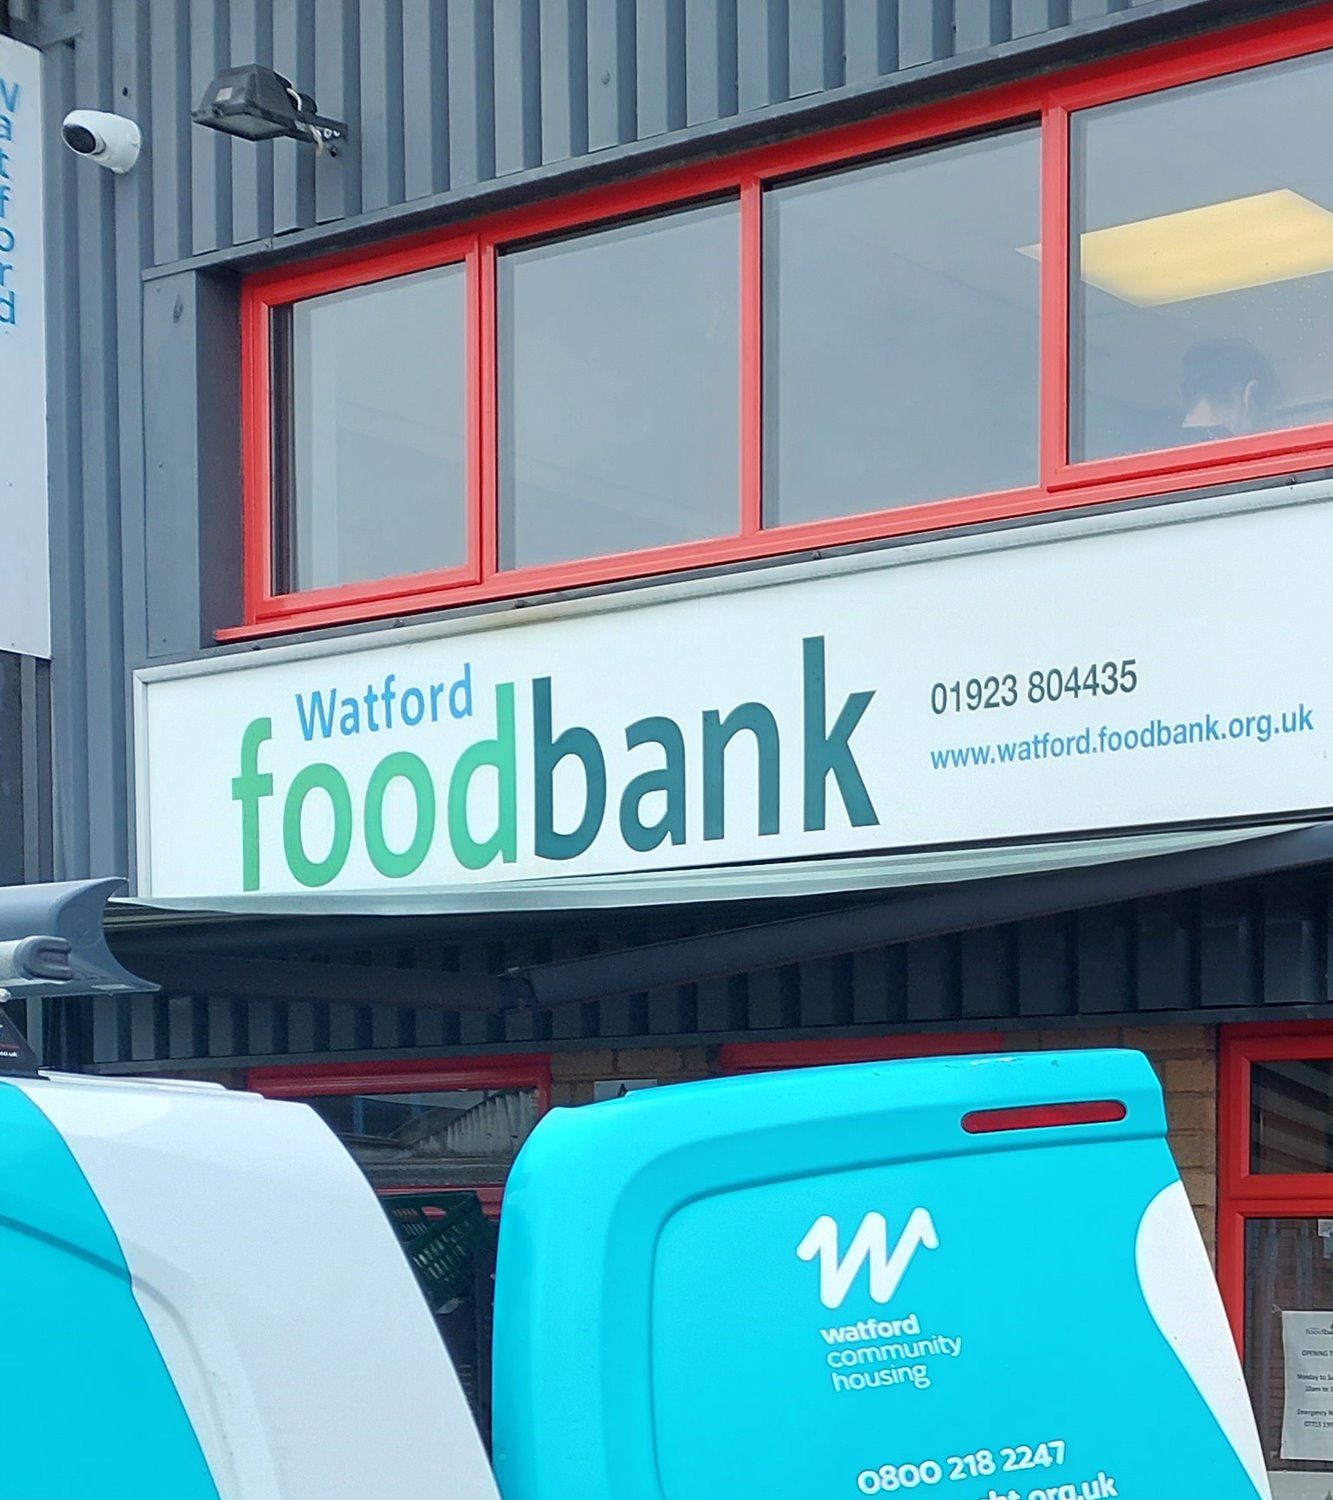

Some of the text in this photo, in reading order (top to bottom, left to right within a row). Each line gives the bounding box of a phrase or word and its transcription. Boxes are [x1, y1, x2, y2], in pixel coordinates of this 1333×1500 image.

[296, 663, 473, 742] Watford
[930, 659, 1138, 714] 01923 804435
[231, 635, 880, 891] foodbank
[930, 703, 1315, 770] www.watford.foodbank.org.uk
[820, 1314, 921, 1345] watford
[827, 1335, 963, 1369] community
[832, 1363, 931, 1393] housing
[857, 1440, 1065, 1495] 0800 218 2247
